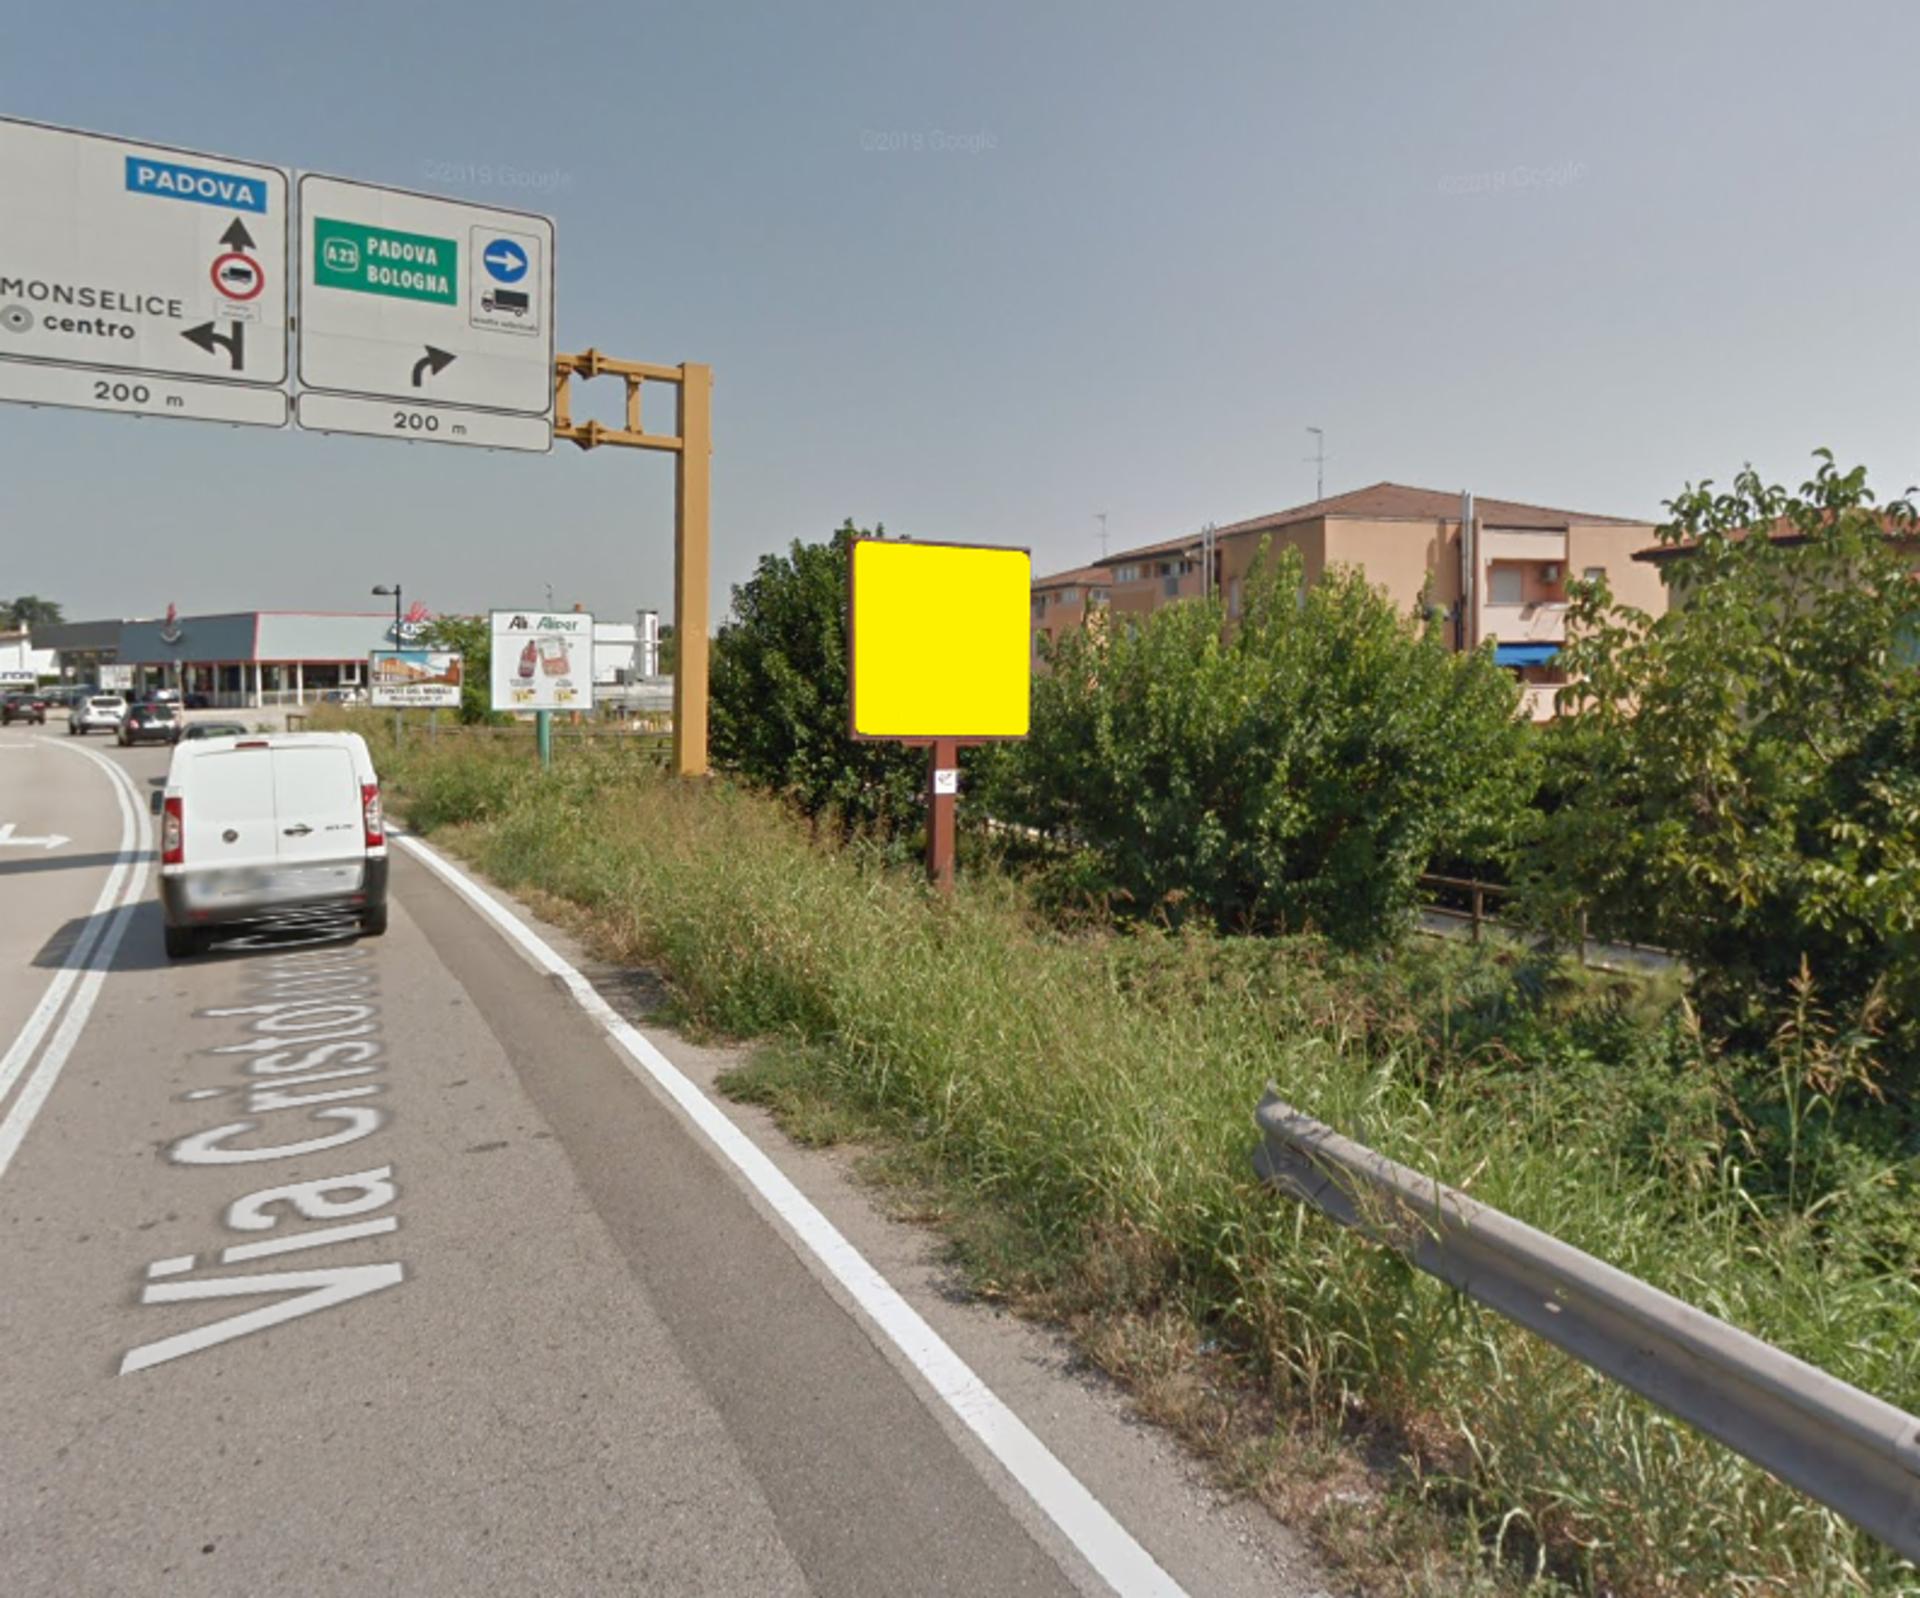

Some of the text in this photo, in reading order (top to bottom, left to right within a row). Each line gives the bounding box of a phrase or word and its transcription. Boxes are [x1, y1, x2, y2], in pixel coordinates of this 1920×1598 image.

[137, 166, 256, 204] PADOVA
[367, 238, 437, 265] PADOVA
[367, 265, 449, 293] BOLOGNA
[0, 277, 183, 319] MONSELICE
[42, 314, 136, 340] centro
[94, 381, 184, 408] 200 m
[393, 412, 467, 435] 200 m
